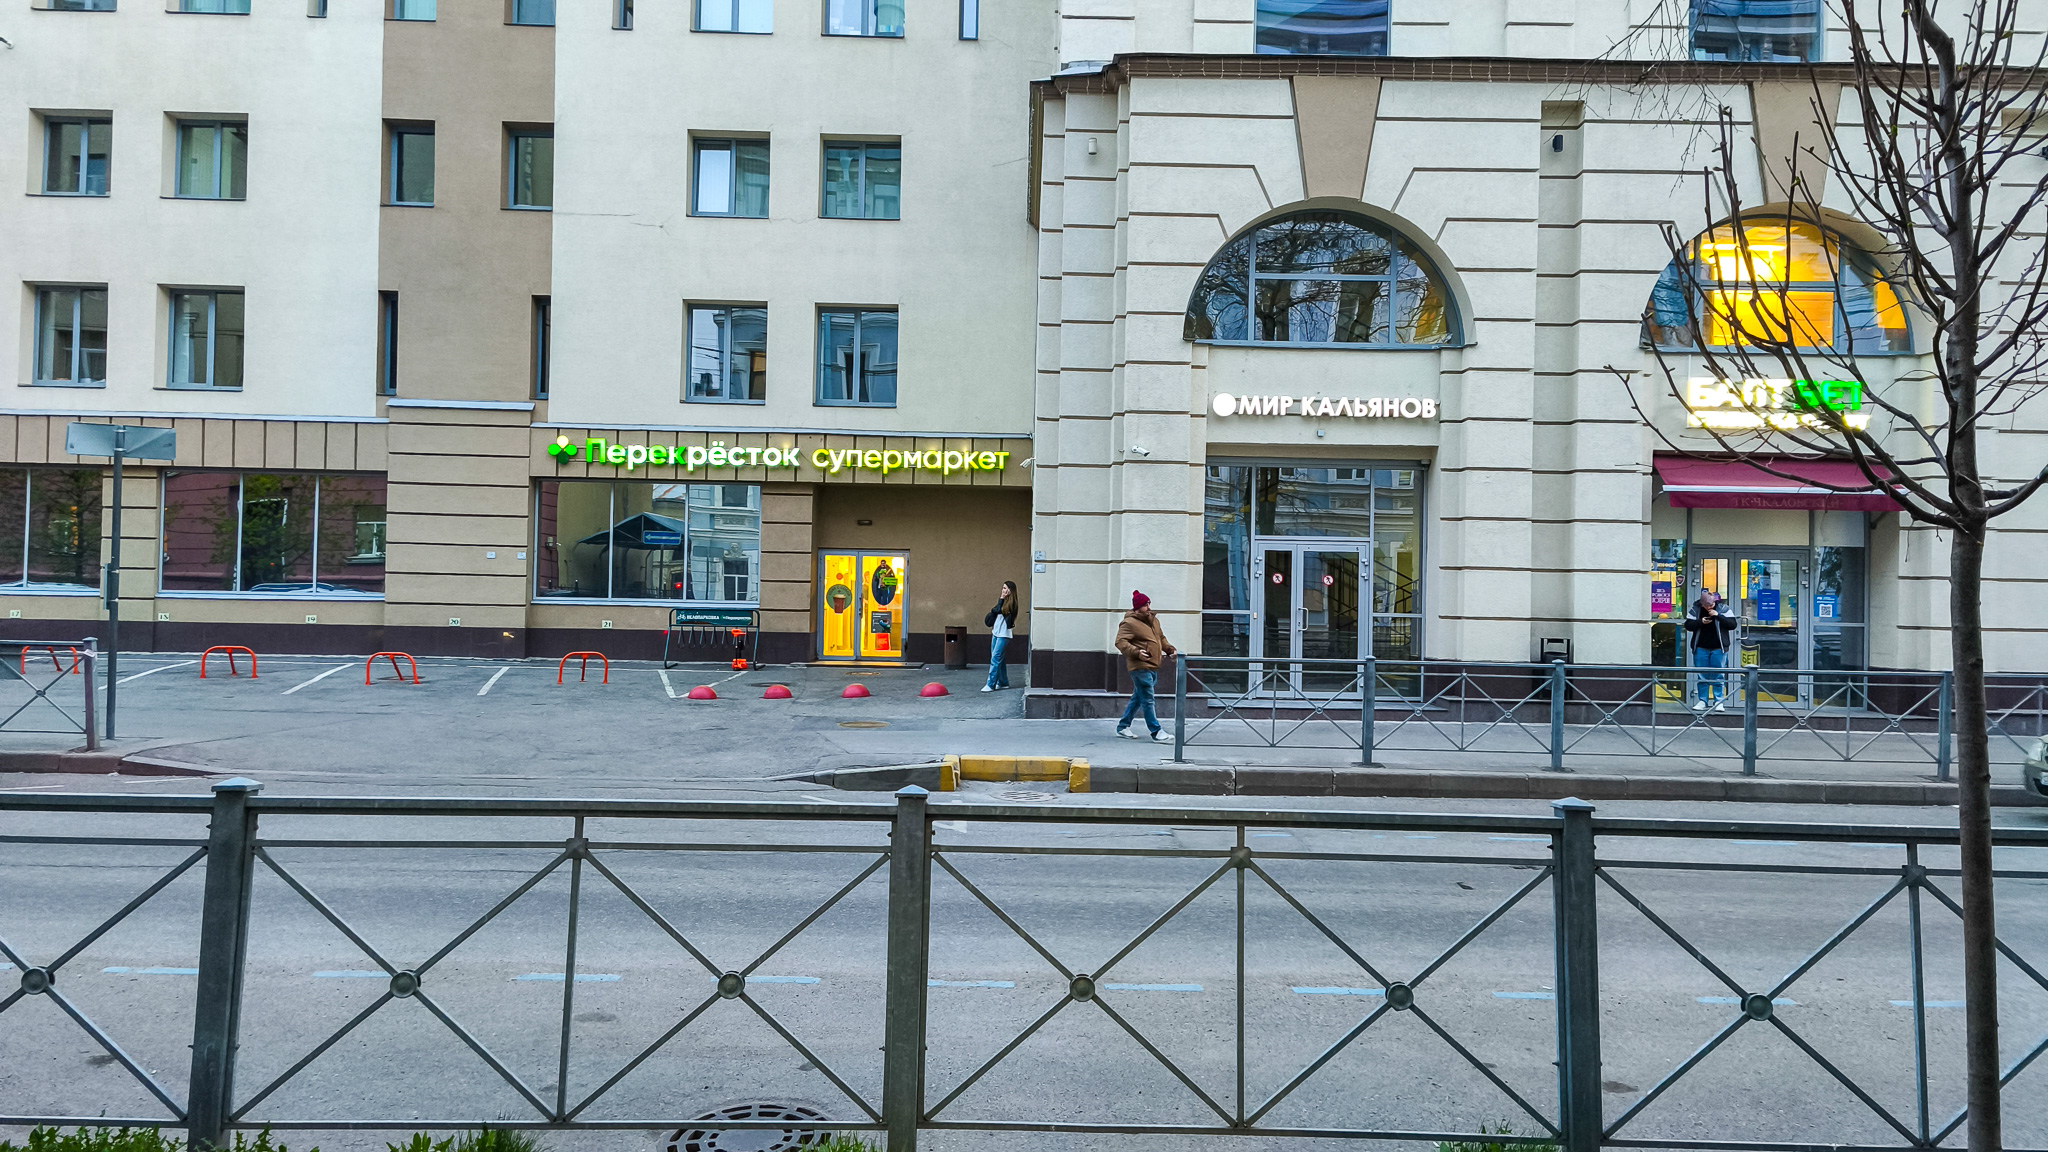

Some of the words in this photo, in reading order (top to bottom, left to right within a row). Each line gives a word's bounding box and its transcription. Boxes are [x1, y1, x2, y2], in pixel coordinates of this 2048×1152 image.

[1238, 394, 1294, 416] МИР
[1301, 396, 1437, 419] КАЛЬЯНОВ
[586, 437, 800, 471] Перекрёсток
[812, 448, 1010, 475] супермаркет
